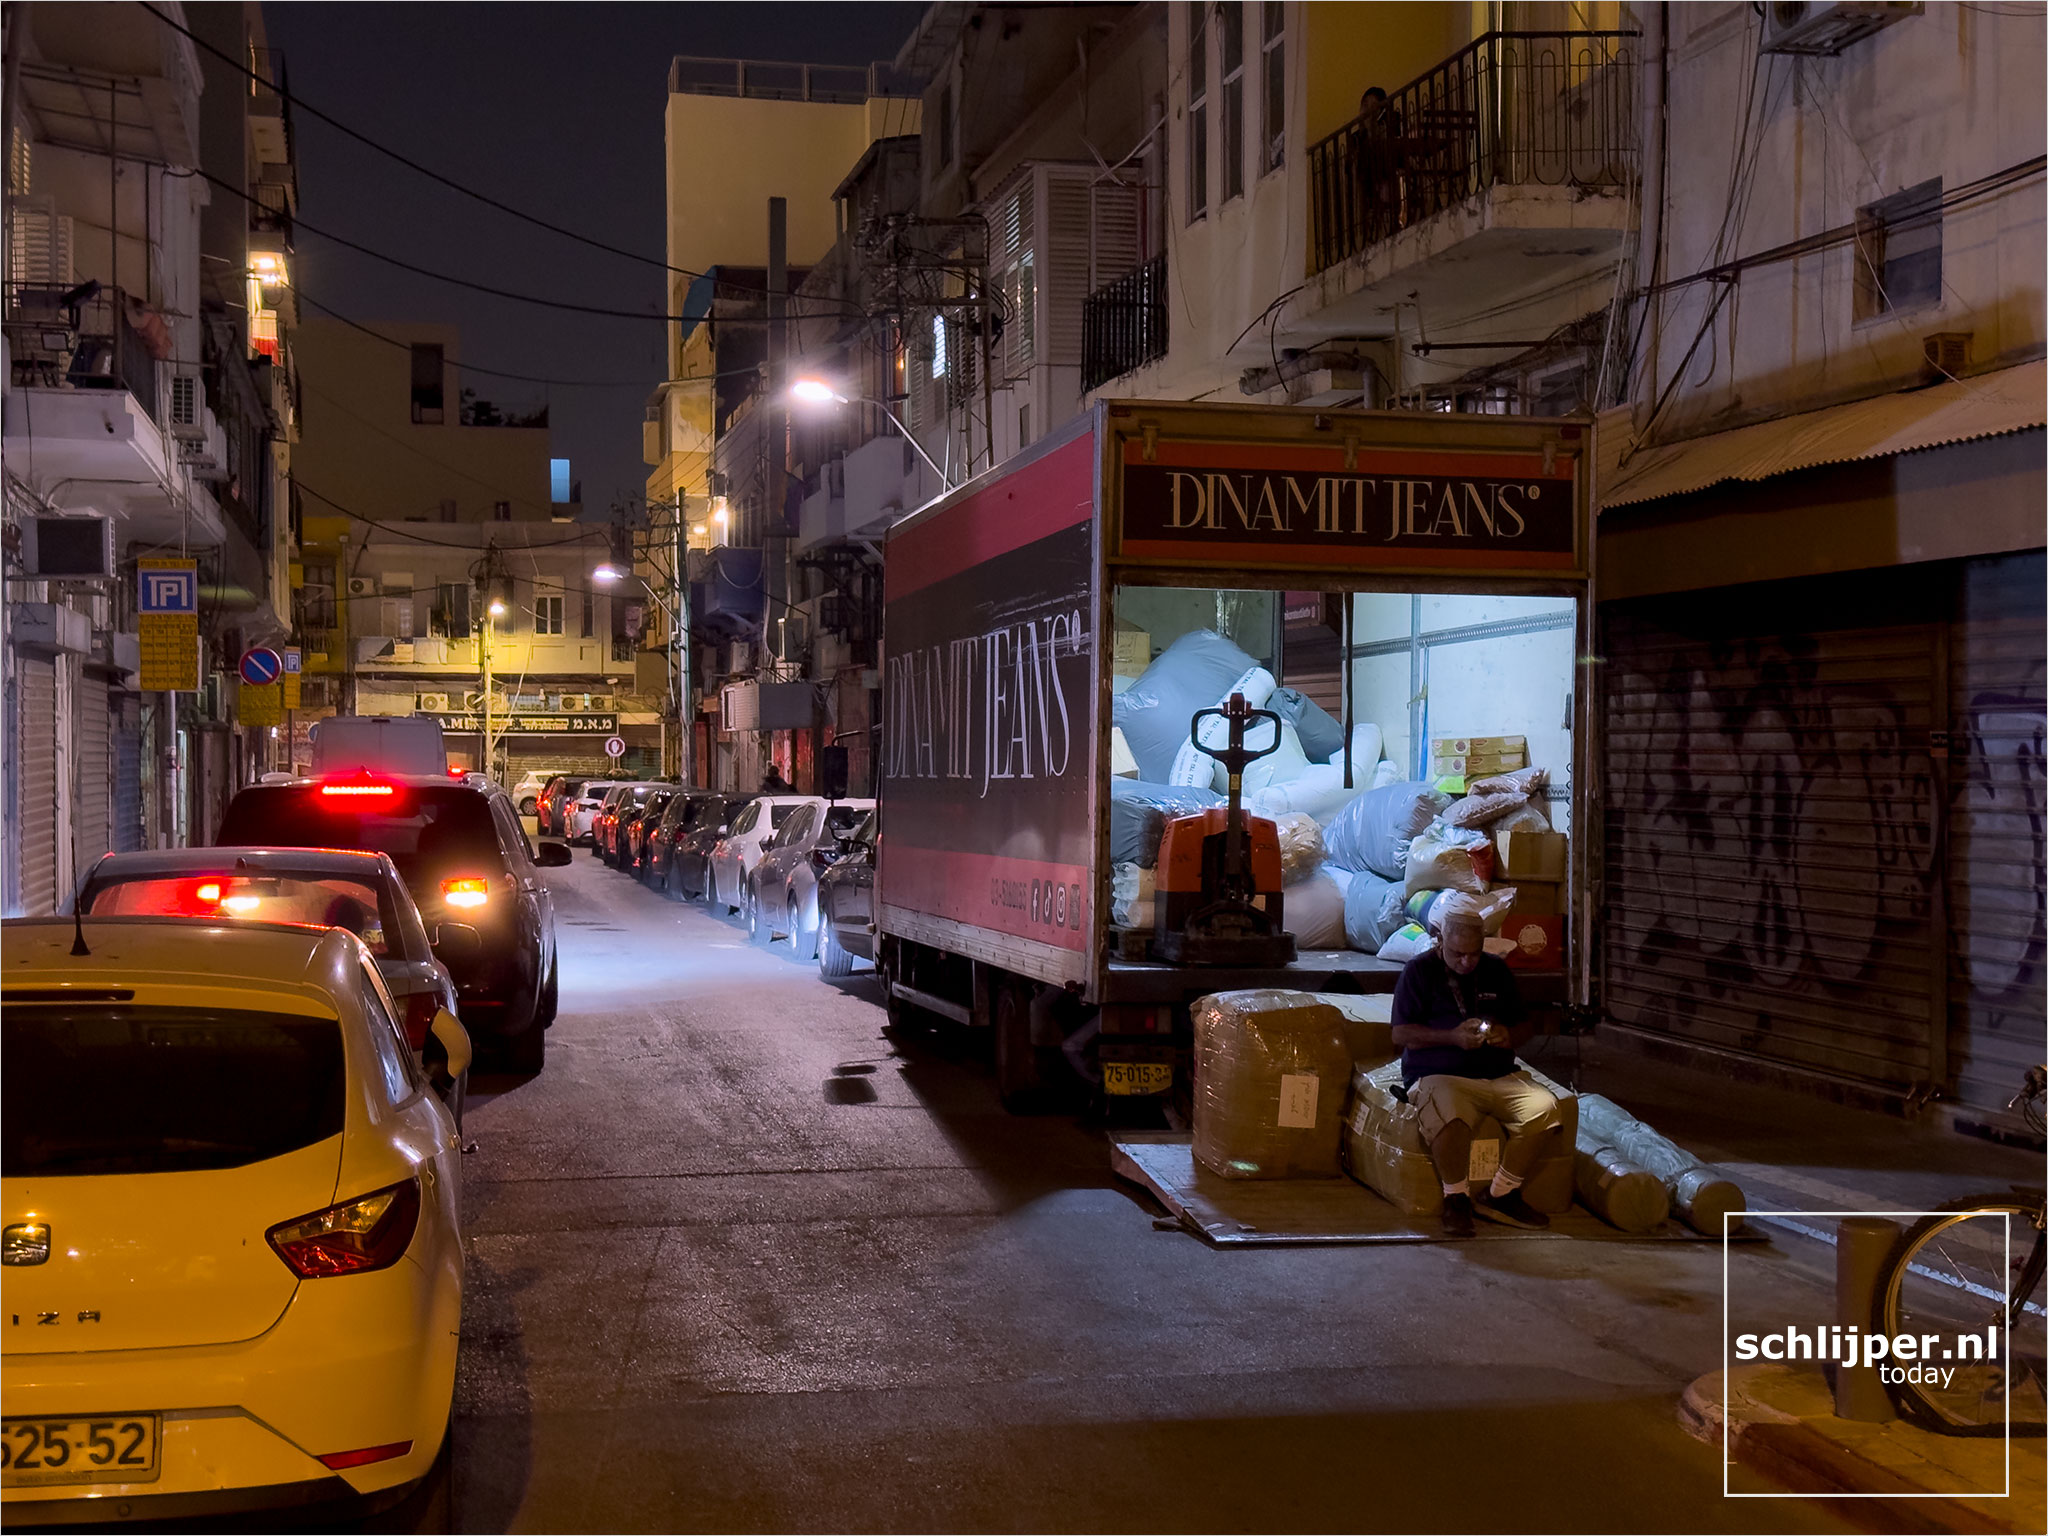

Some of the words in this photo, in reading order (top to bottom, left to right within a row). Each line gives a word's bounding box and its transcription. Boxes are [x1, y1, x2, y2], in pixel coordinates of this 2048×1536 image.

[1163, 472, 1376, 534] DINAMIT
[573, 718, 613, 730] מ.א.מ
[886, 636, 978, 778] DINAMIT
